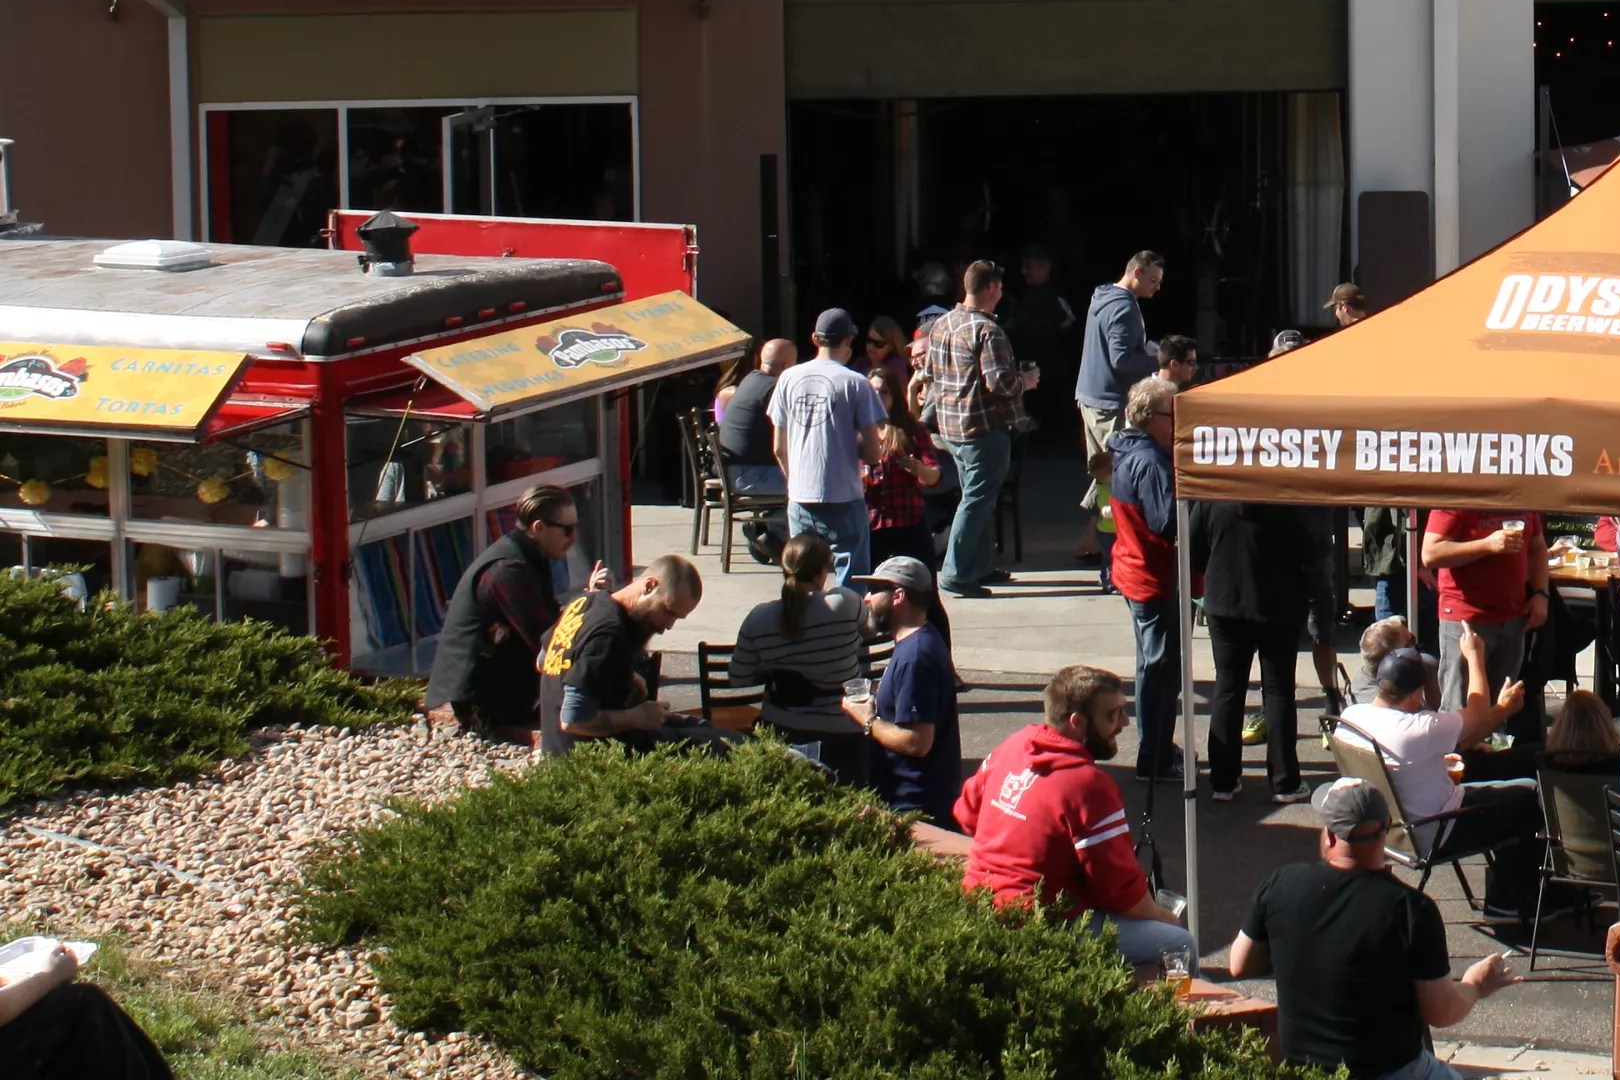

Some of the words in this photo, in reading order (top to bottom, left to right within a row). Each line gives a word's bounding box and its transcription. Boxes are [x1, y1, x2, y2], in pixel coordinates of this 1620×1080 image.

[110, 357, 225, 376] CARNITAS
[436, 342, 522, 369] CATERING
[476, 369, 565, 396] WEDDINGS
[96, 397, 183, 415] TORTAS
[1192, 425, 1342, 470] ODYSSEY
[1355, 429, 1574, 477] BEERWERKS
